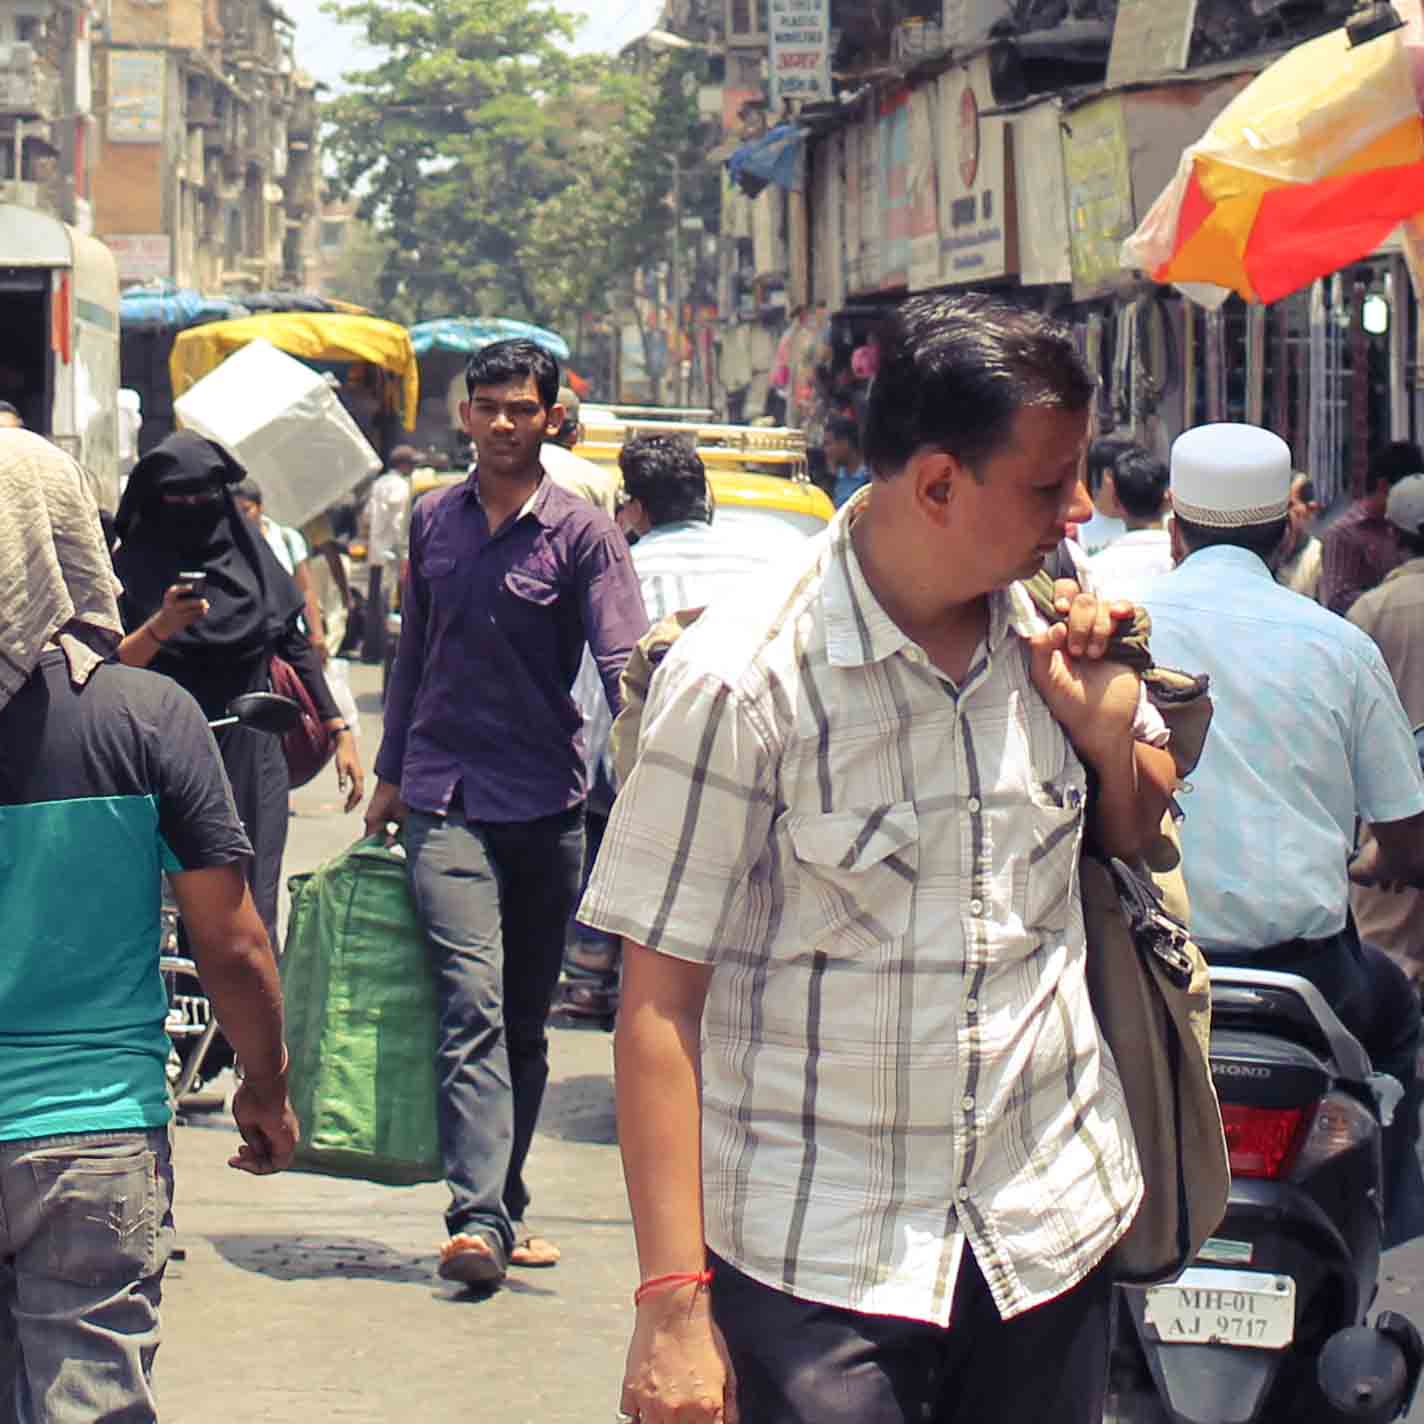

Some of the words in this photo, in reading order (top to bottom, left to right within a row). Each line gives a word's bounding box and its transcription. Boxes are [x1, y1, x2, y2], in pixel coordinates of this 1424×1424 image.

[1177, 1288, 1256, 1314] MH-01
[1167, 1318, 1201, 1336] AJ
[1216, 1316, 1268, 1340] 9717
